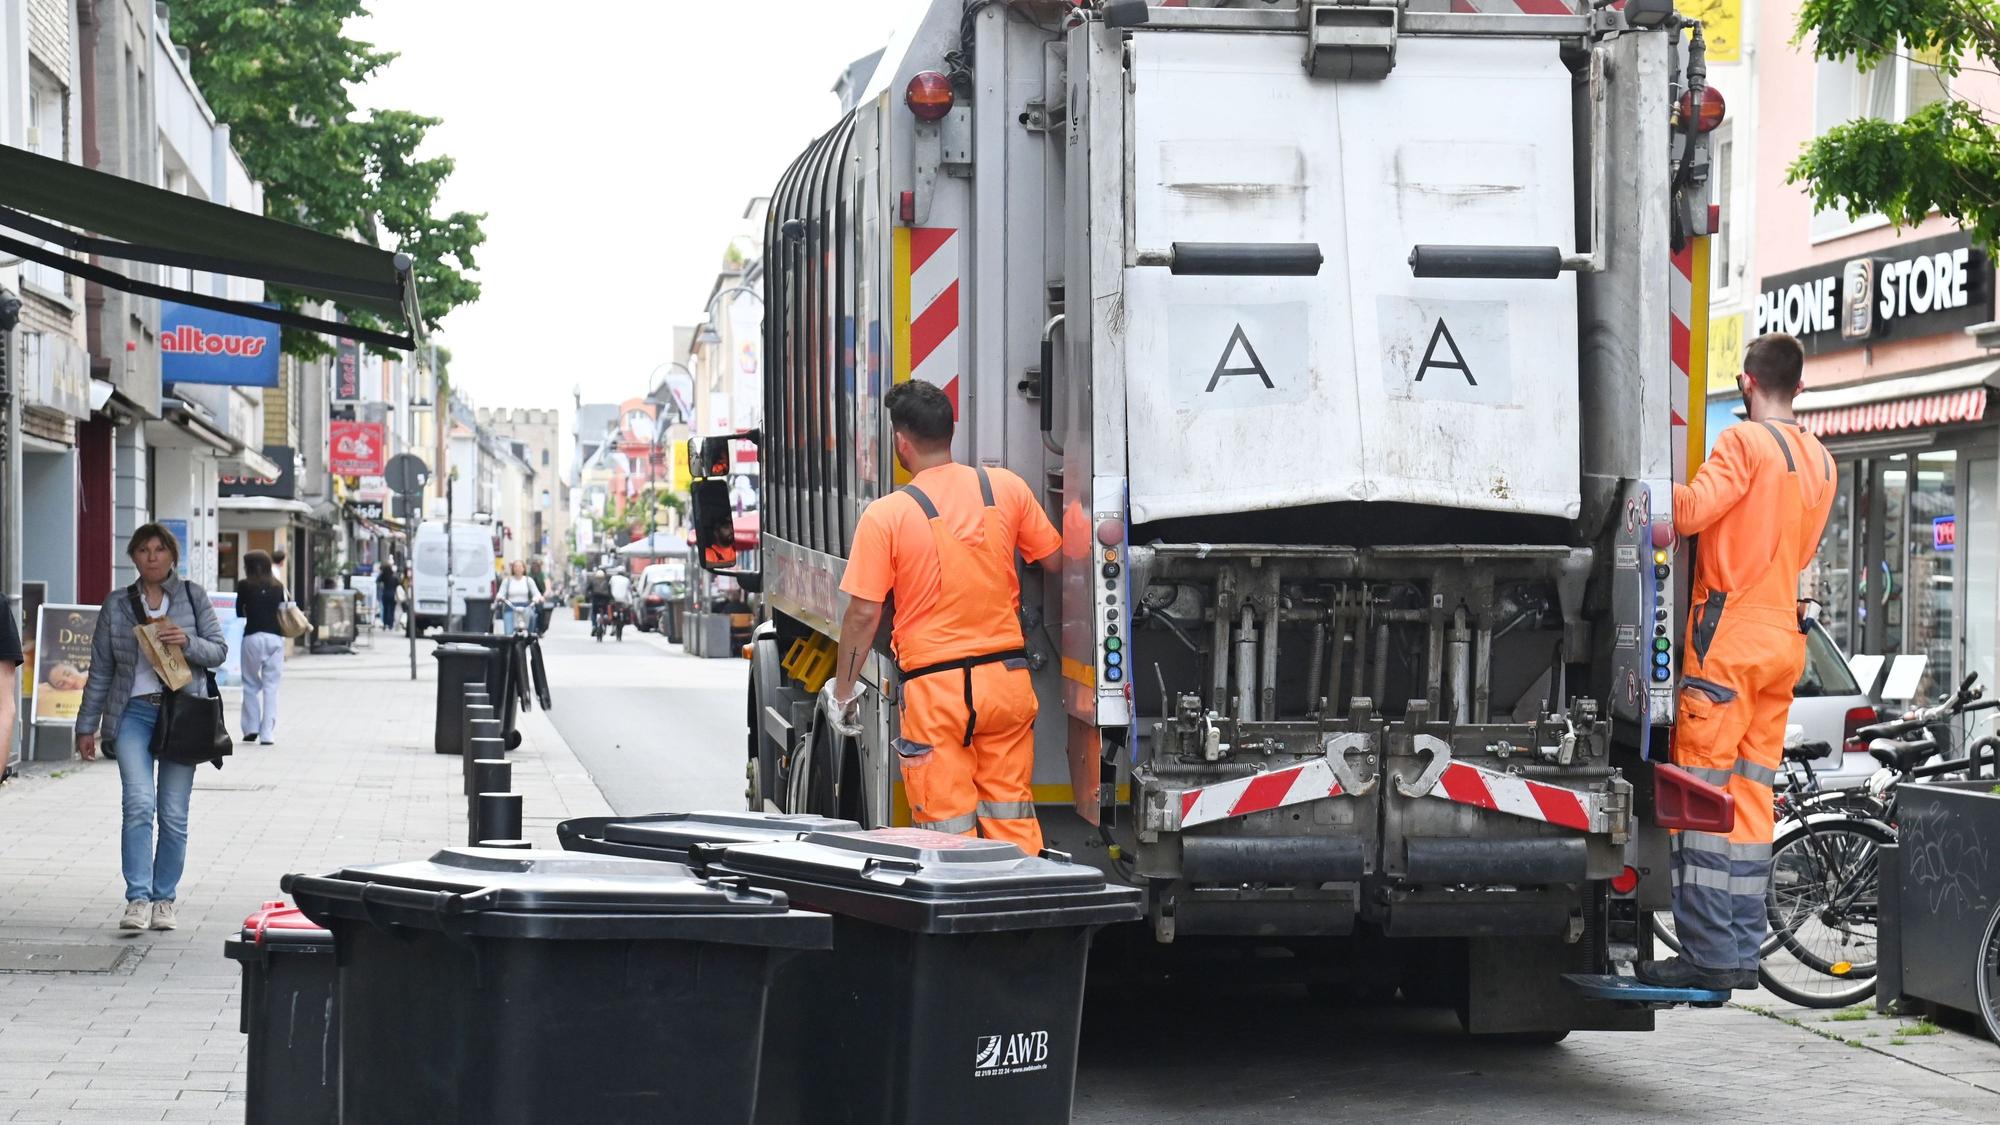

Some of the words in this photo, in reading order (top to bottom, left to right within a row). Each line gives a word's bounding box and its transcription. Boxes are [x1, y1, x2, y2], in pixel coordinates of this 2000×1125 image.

[1754, 276, 1836, 338] PHONE
[1880, 248, 1968, 319] STORE
[160, 325, 266, 357] alltours
[1205, 322, 1275, 393] A
[1414, 316, 1478, 386] A
[59, 628, 92, 645] Dre
[1002, 1030, 1048, 1066] AWB
